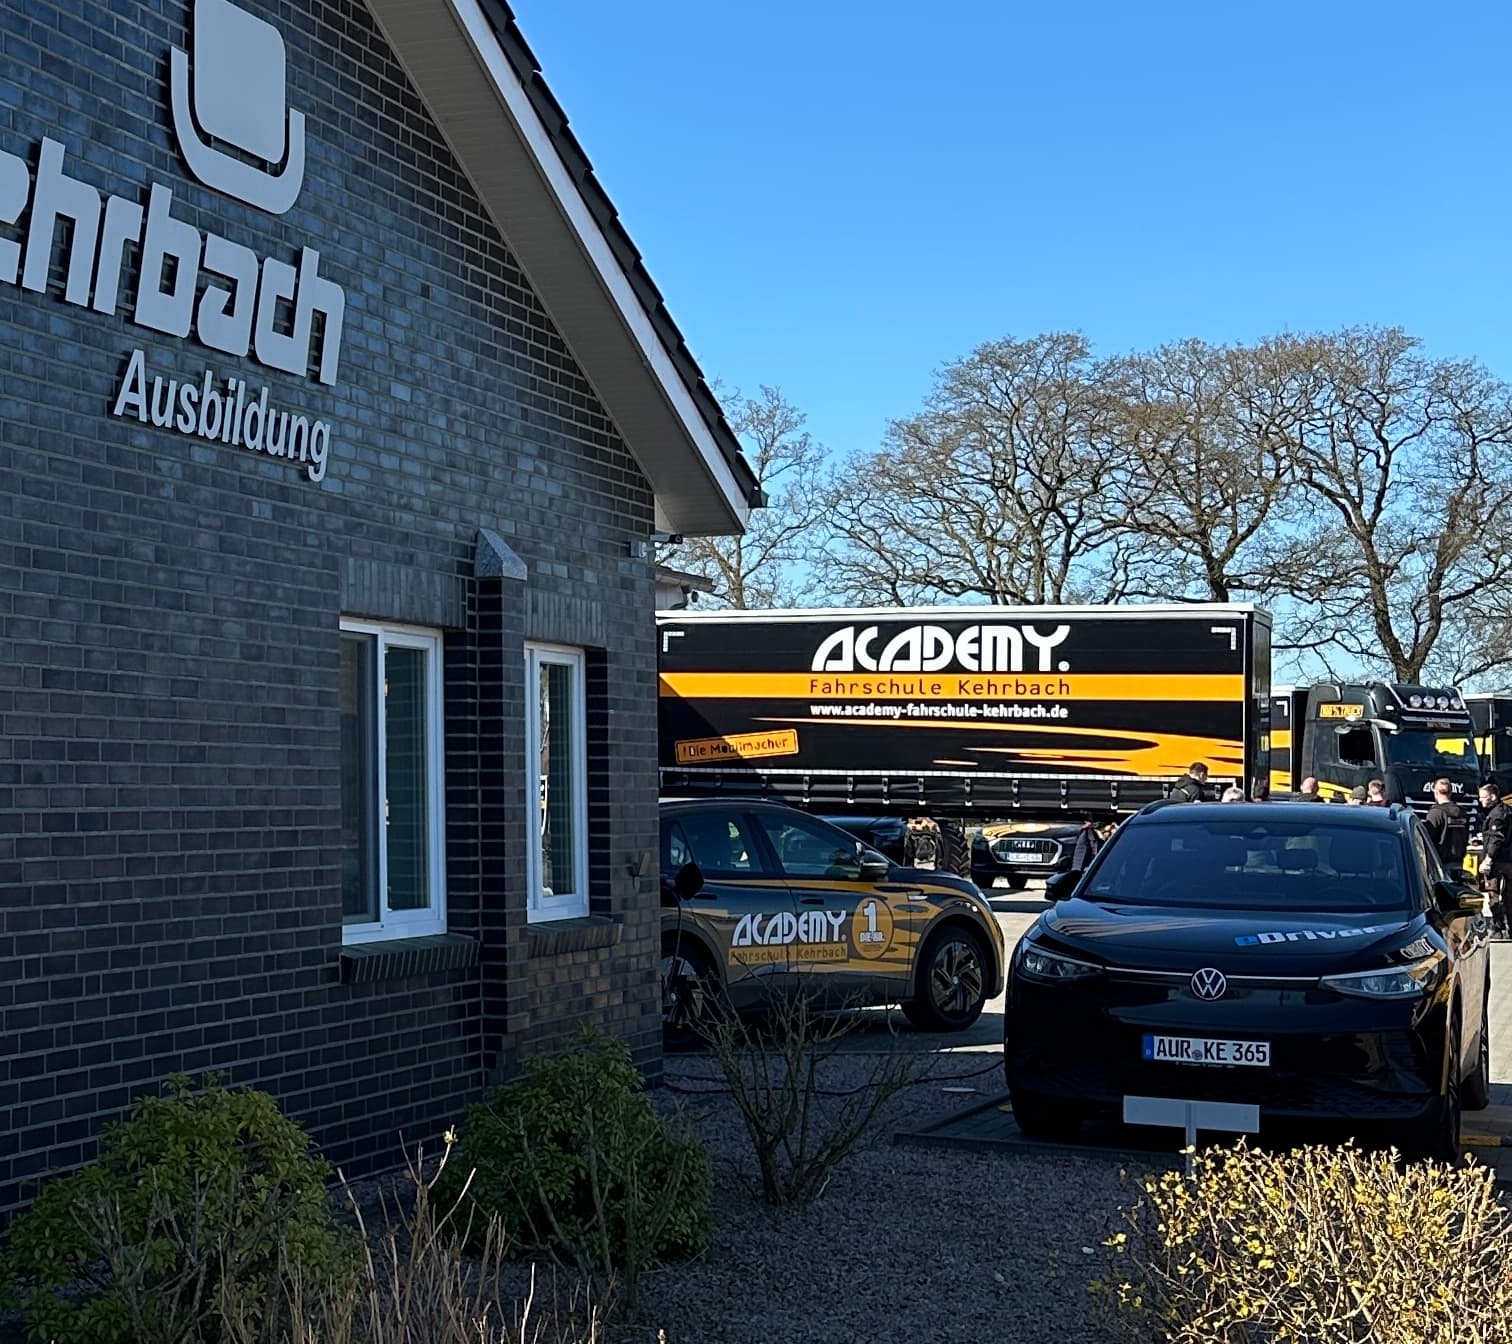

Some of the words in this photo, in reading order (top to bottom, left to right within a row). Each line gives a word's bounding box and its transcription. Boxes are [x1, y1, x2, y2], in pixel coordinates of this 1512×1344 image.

[113, 349, 331, 482] Ausbildung
[810, 679, 942, 695] Fahrschule
[958, 679, 1070, 695] Kehrbach
[810, 703, 1069, 719] www.academy-fahrschule-kehrbach.de
[798, 947, 847, 959] Kehrbach
[1156, 1038, 1191, 1058] AUR
[1204, 1041, 1228, 1061] KE
[1232, 1042, 1267, 1063] 365
